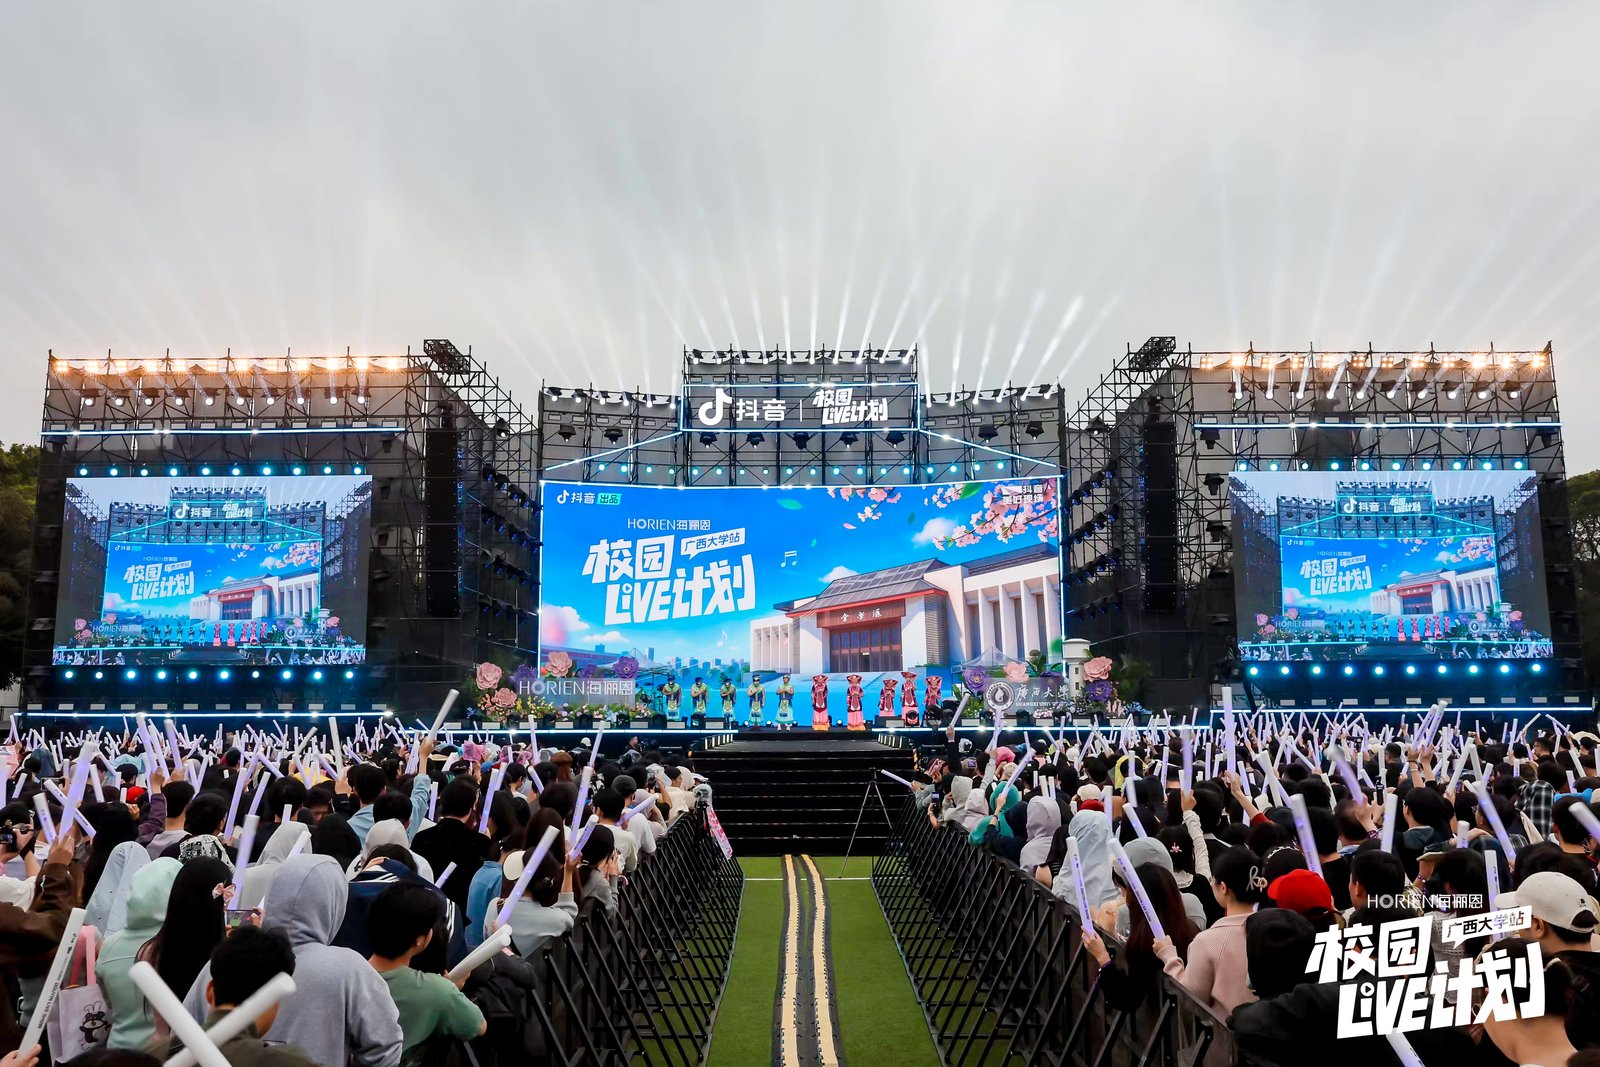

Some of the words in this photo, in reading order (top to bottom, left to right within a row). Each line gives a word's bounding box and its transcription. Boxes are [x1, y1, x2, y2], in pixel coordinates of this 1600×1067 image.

[812, 389, 853, 407] 校园
[736, 399, 786, 422] 抖音
[571, 492, 595, 504] 抖音
[600, 494, 618, 504] 出品
[684, 531, 741, 552] 广西大学站
[582, 535, 675, 584] 校园
[1300, 558, 1338, 579] 校园
[123, 563, 163, 584] 校园
[48, 982, 59, 1002] DOUYIN
[37, 1013, 47, 1029] SHOW
